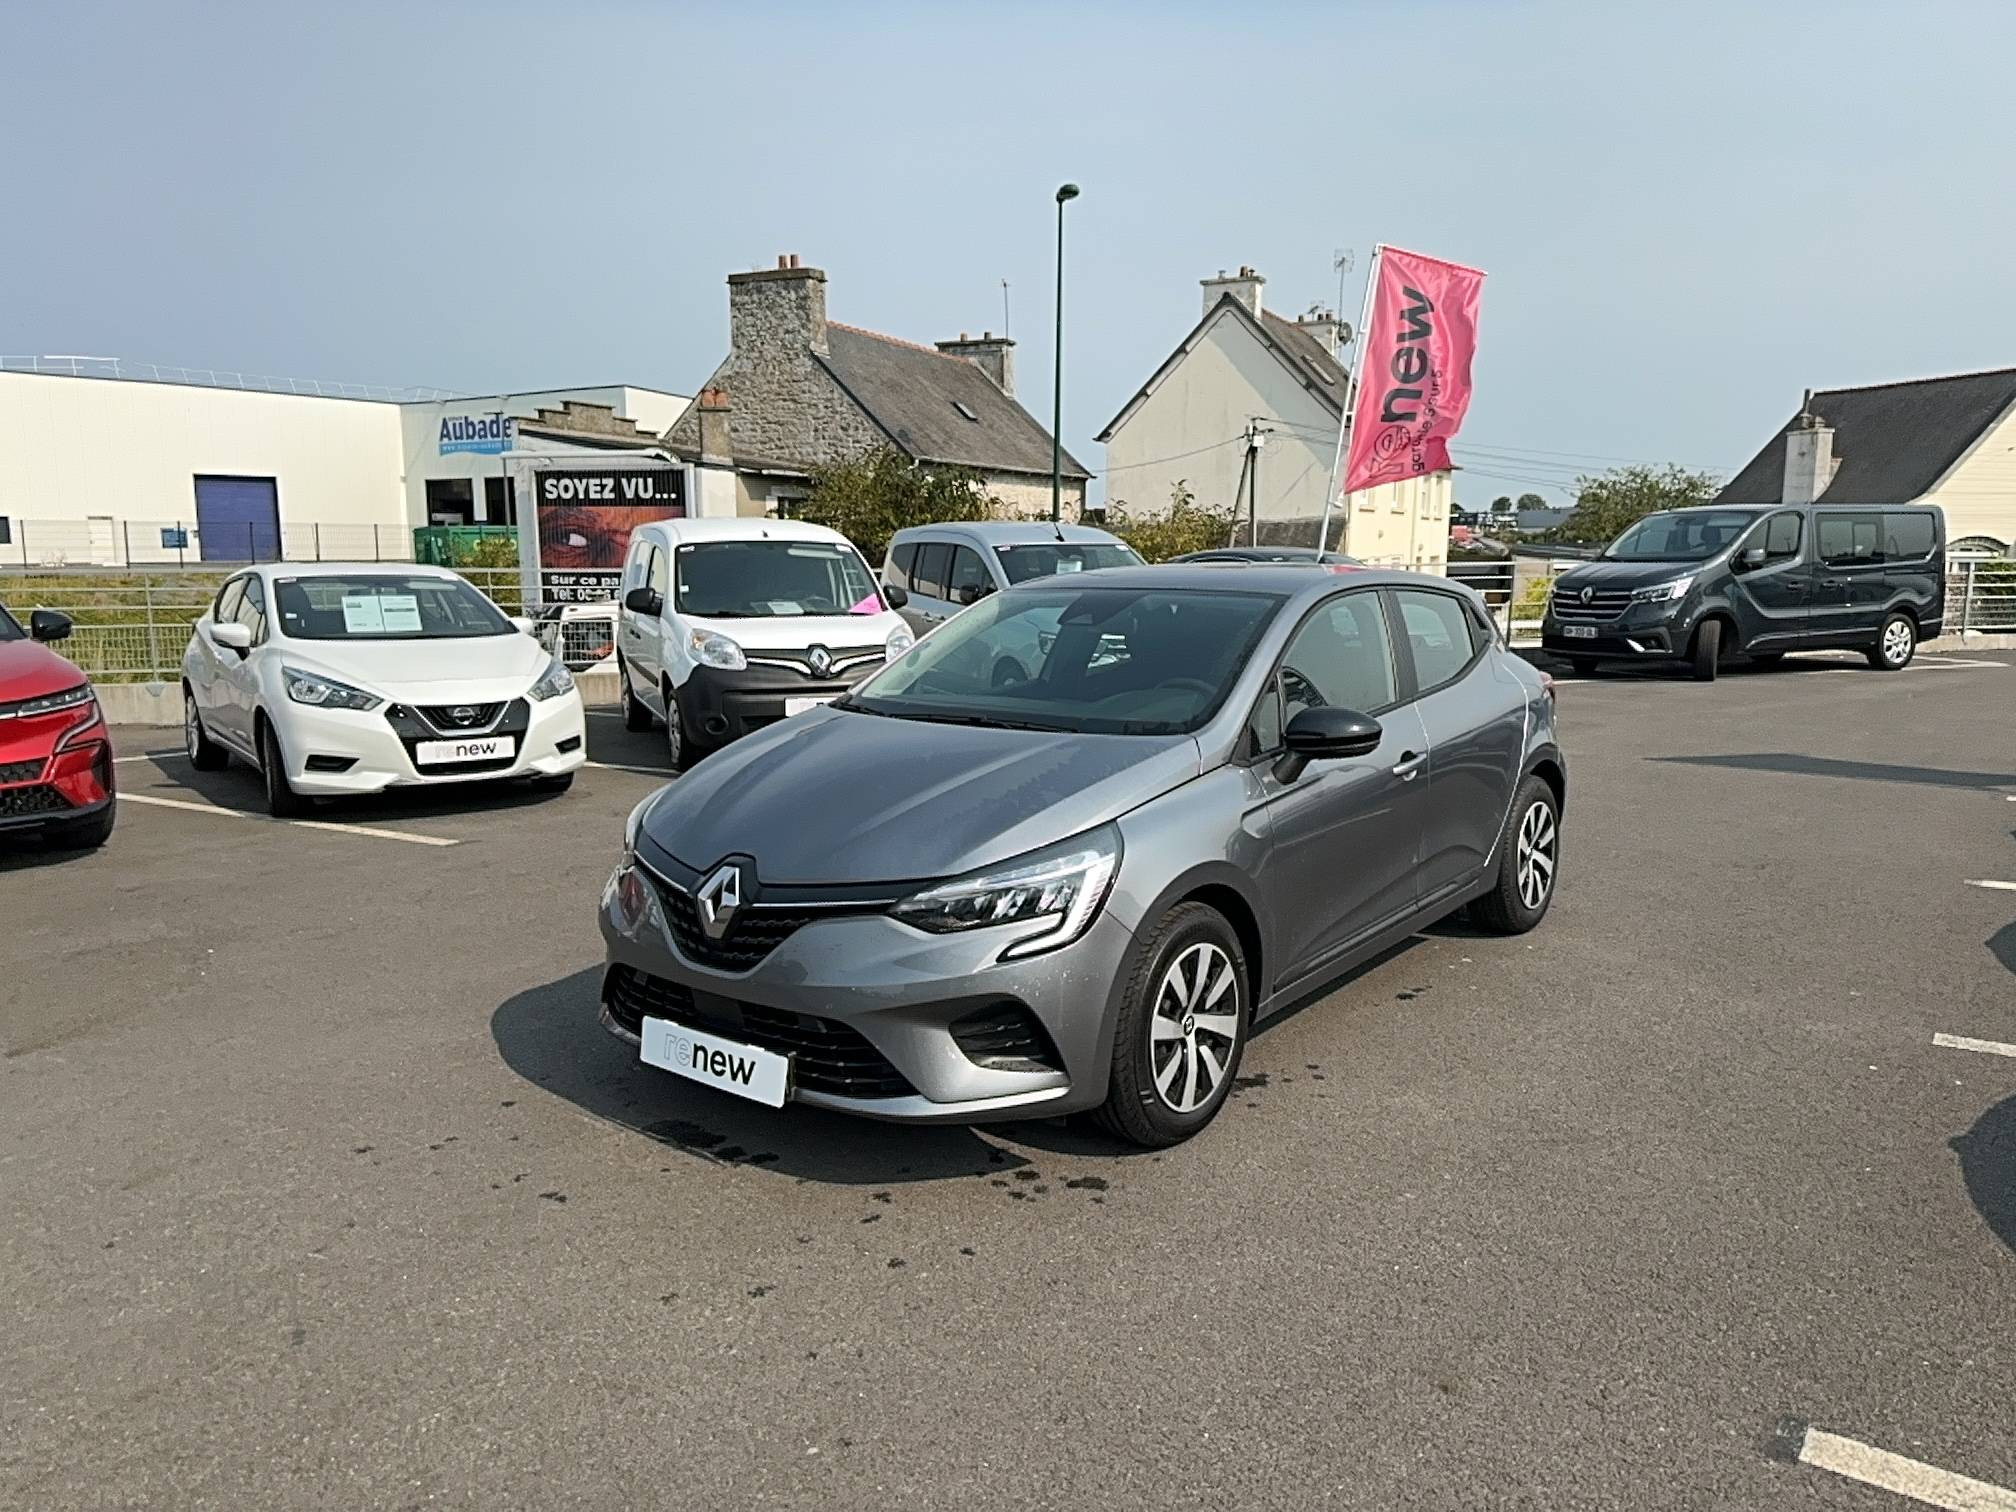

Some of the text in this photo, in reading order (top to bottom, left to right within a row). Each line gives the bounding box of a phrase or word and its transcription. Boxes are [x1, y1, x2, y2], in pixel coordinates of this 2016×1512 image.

[1368, 285, 1434, 479] renew
[440, 414, 512, 442] Aubade
[544, 477, 677, 499] SOYEZ VU...
[551, 575, 577, 585] Sur
[663, 1032, 757, 1086] renew
